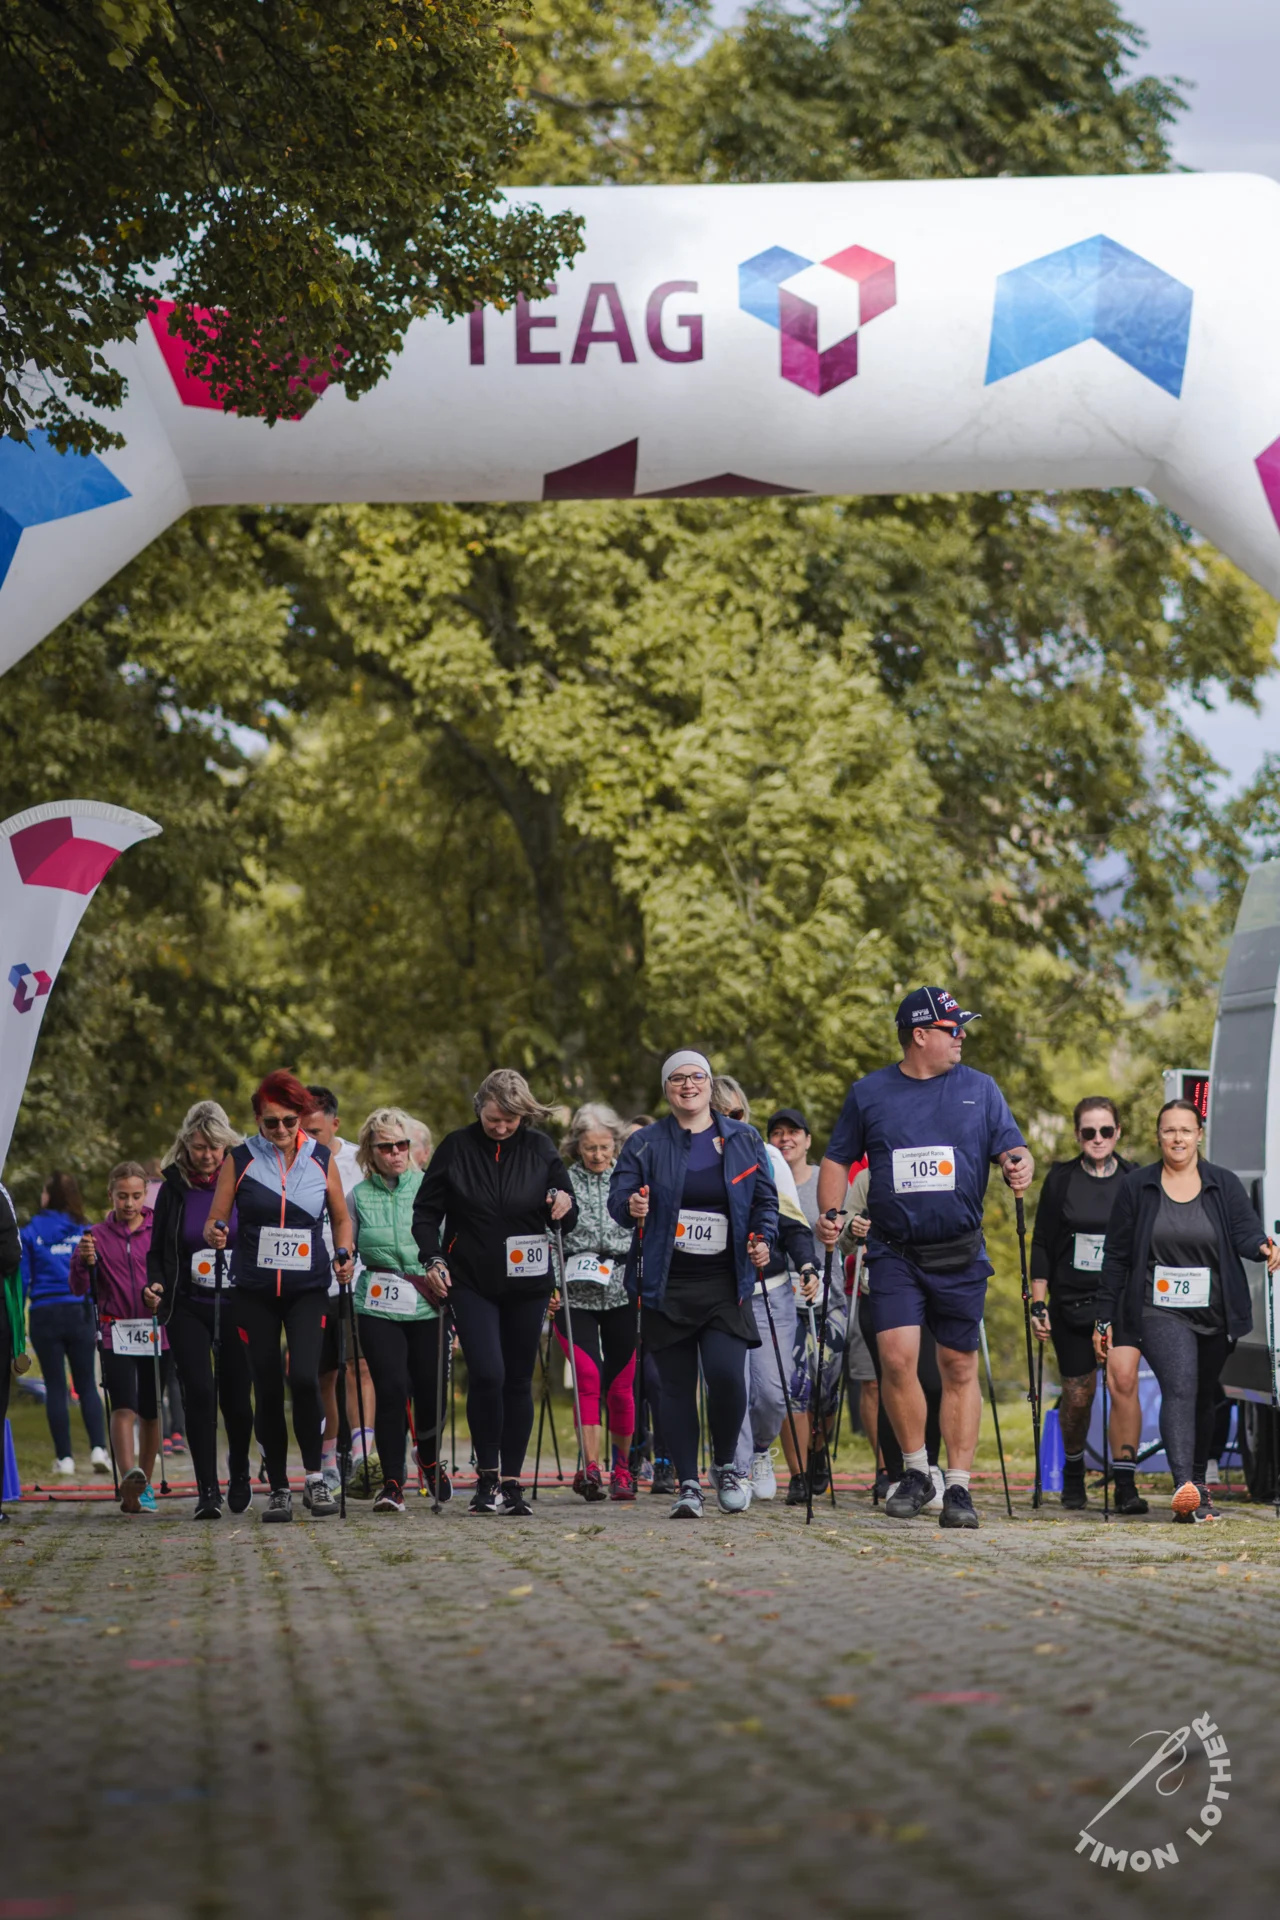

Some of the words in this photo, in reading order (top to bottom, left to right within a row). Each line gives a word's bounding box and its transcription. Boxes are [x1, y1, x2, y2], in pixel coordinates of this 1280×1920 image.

[902, 1150, 930, 1158] Limberglauf
[910, 1160, 938, 1177] 105
[680, 1214, 707, 1223] Limberglauf
[687, 1224, 712, 1241] 104
[274, 1241, 298, 1257] 137
[527, 1247, 542, 1263] 80
[577, 1259, 598, 1271] 125
[384, 1285, 399, 1301] 13
[1173, 1280, 1190, 1295] 78
[127, 1330, 149, 1344] 145
